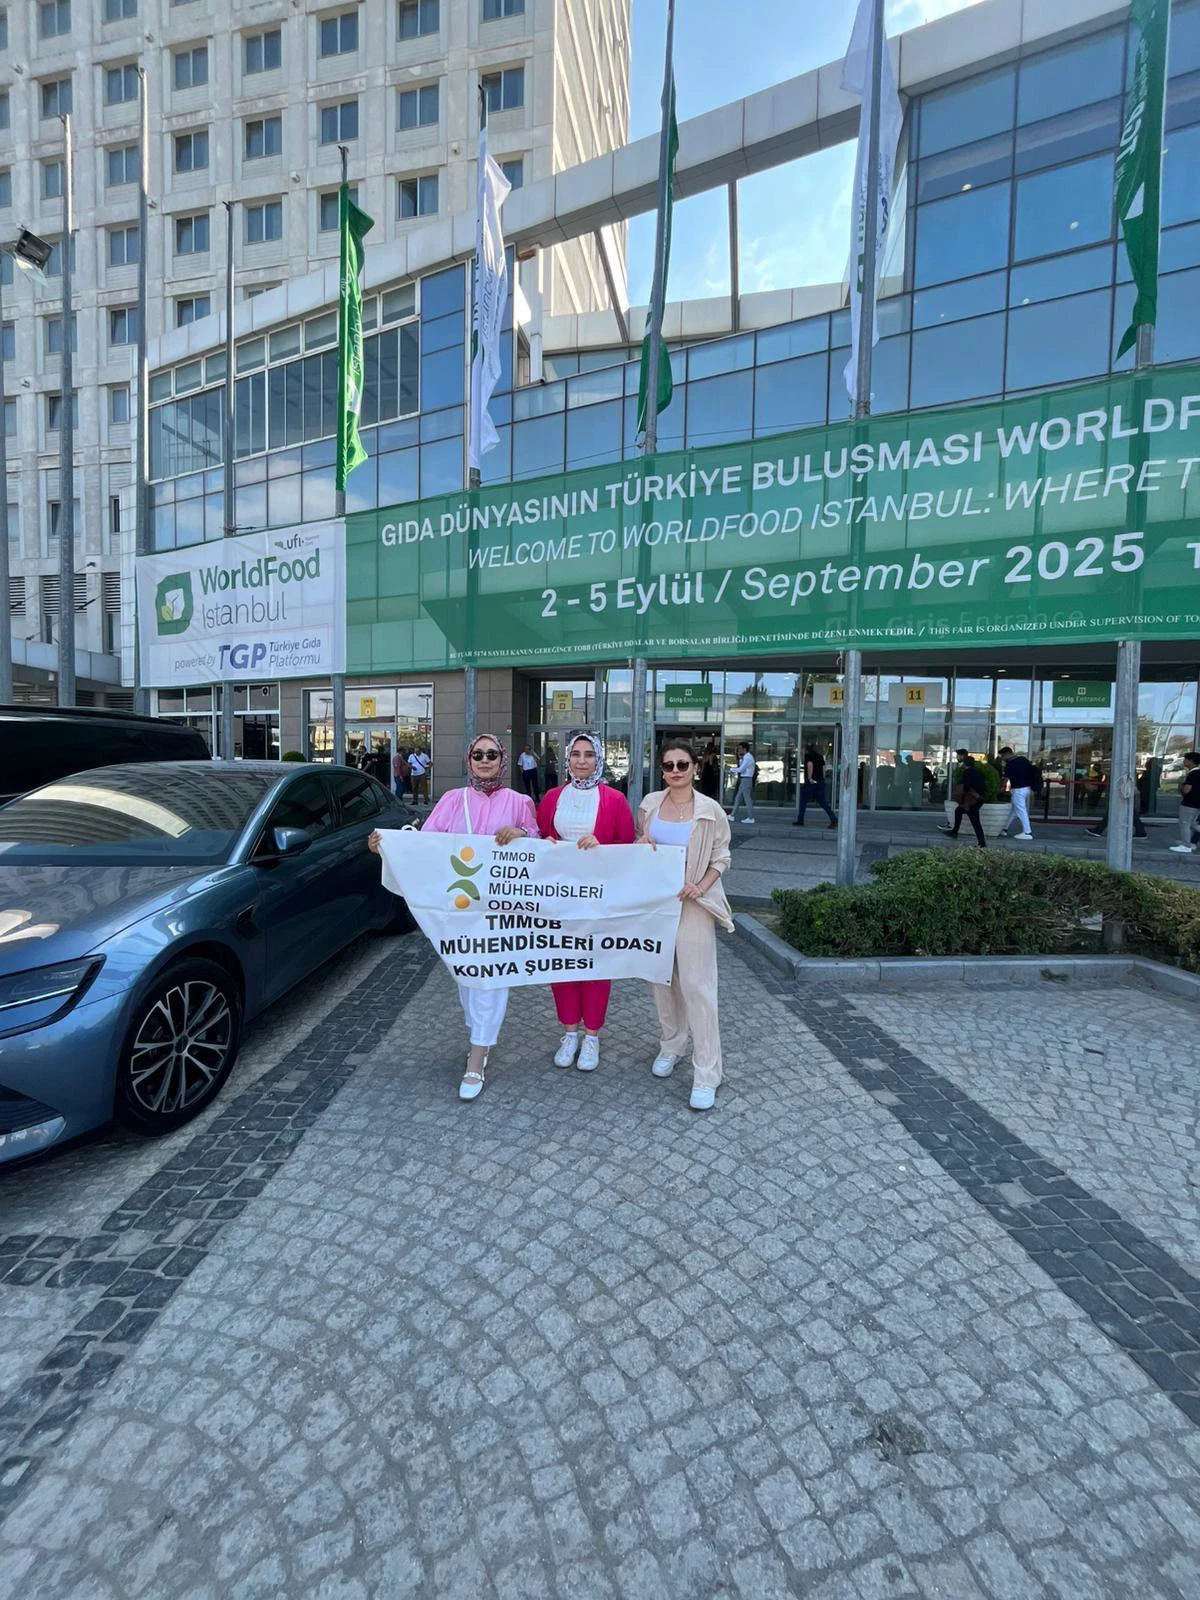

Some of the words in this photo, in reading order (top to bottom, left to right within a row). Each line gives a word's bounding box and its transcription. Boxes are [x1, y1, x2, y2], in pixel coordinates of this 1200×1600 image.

[381, 518, 435, 547] GIDA
[440, 487, 598, 538] DÜNYASININ
[606, 463, 742, 509] TÜRKİYE
[752, 431, 982, 490] BULUŞMASI
[996, 394, 1200, 458] WORLDF
[468, 534, 582, 570] WELCOME
[588, 529, 617, 555] TO
[622, 505, 802, 551] WORLDFOOD
[810, 486, 992, 531] ISTANBUL:
[1004, 458, 1167, 511] WHERE
[1176, 456, 1200, 490] T
[199, 547, 321, 596] WorldFood
[541, 588, 557, 618] 2
[567, 598, 580, 606] -
[589, 582, 608, 613] 5
[616, 570, 705, 616] Eylül
[714, 569, 733, 605] /
[740, 552, 990, 607] September
[1003, 531, 1145, 584] 2025
[202, 591, 287, 630] Istanbul
[656, 638, 666, 646] VE
[668, 637, 711, 646] BORSALAR
[749, 631, 810, 643] DENETİMİNDE
[929, 626, 950, 635] THIS
[952, 625, 974, 634] FAIR
[976, 624, 985, 633] IS
[986, 622, 1047, 633] ORGANIZED
[1049, 619, 1087, 630] UNDER
[1090, 614, 1165, 627] SUPERVISION
[1166, 614, 1182, 624] OF
[218, 643, 267, 670] TGP
[269, 640, 300, 653] Türkiye
[174, 653, 207, 673] powered
[269, 652, 321, 668] Platformu
[908, 689, 922, 700] 11
[492, 850, 536, 862] TMMOB
[490, 864, 530, 879] GIDA
[489, 880, 604, 899] MÜHENDİSLERİ
[488, 900, 540, 912] ODASI
[485, 914, 562, 931] TMMOB
[440, 931, 594, 956] MÜHENDİSLERİ
[601, 936, 662, 954] ODASI
[453, 961, 519, 978] KONYA
[525, 957, 594, 977] ŞUBESİ
